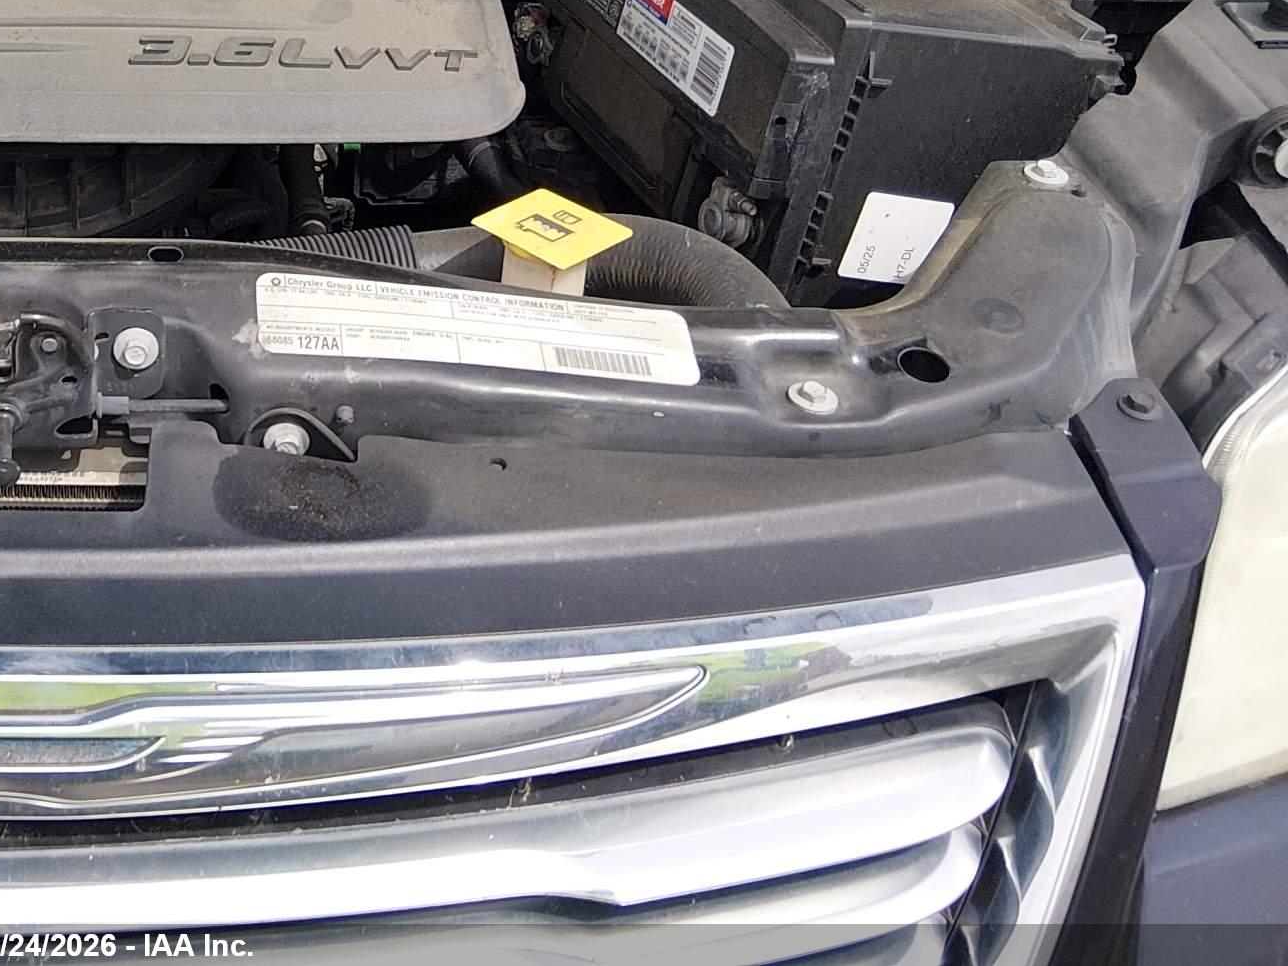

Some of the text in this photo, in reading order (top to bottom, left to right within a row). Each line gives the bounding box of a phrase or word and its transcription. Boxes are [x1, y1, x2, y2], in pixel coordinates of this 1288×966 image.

[857, 245, 876, 274] 05/25
[893, 247, 916, 278] H7-DL
[287, 278, 373, 292] Chrysler Group LLC
[379, 286, 414, 297] VEHICLE
[418, 290, 459, 301] EMISSION
[463, 294, 501, 305] CONTROL
[505, 299, 565, 311] INFORMATION
[297, 335, 340, 351] 127AA
